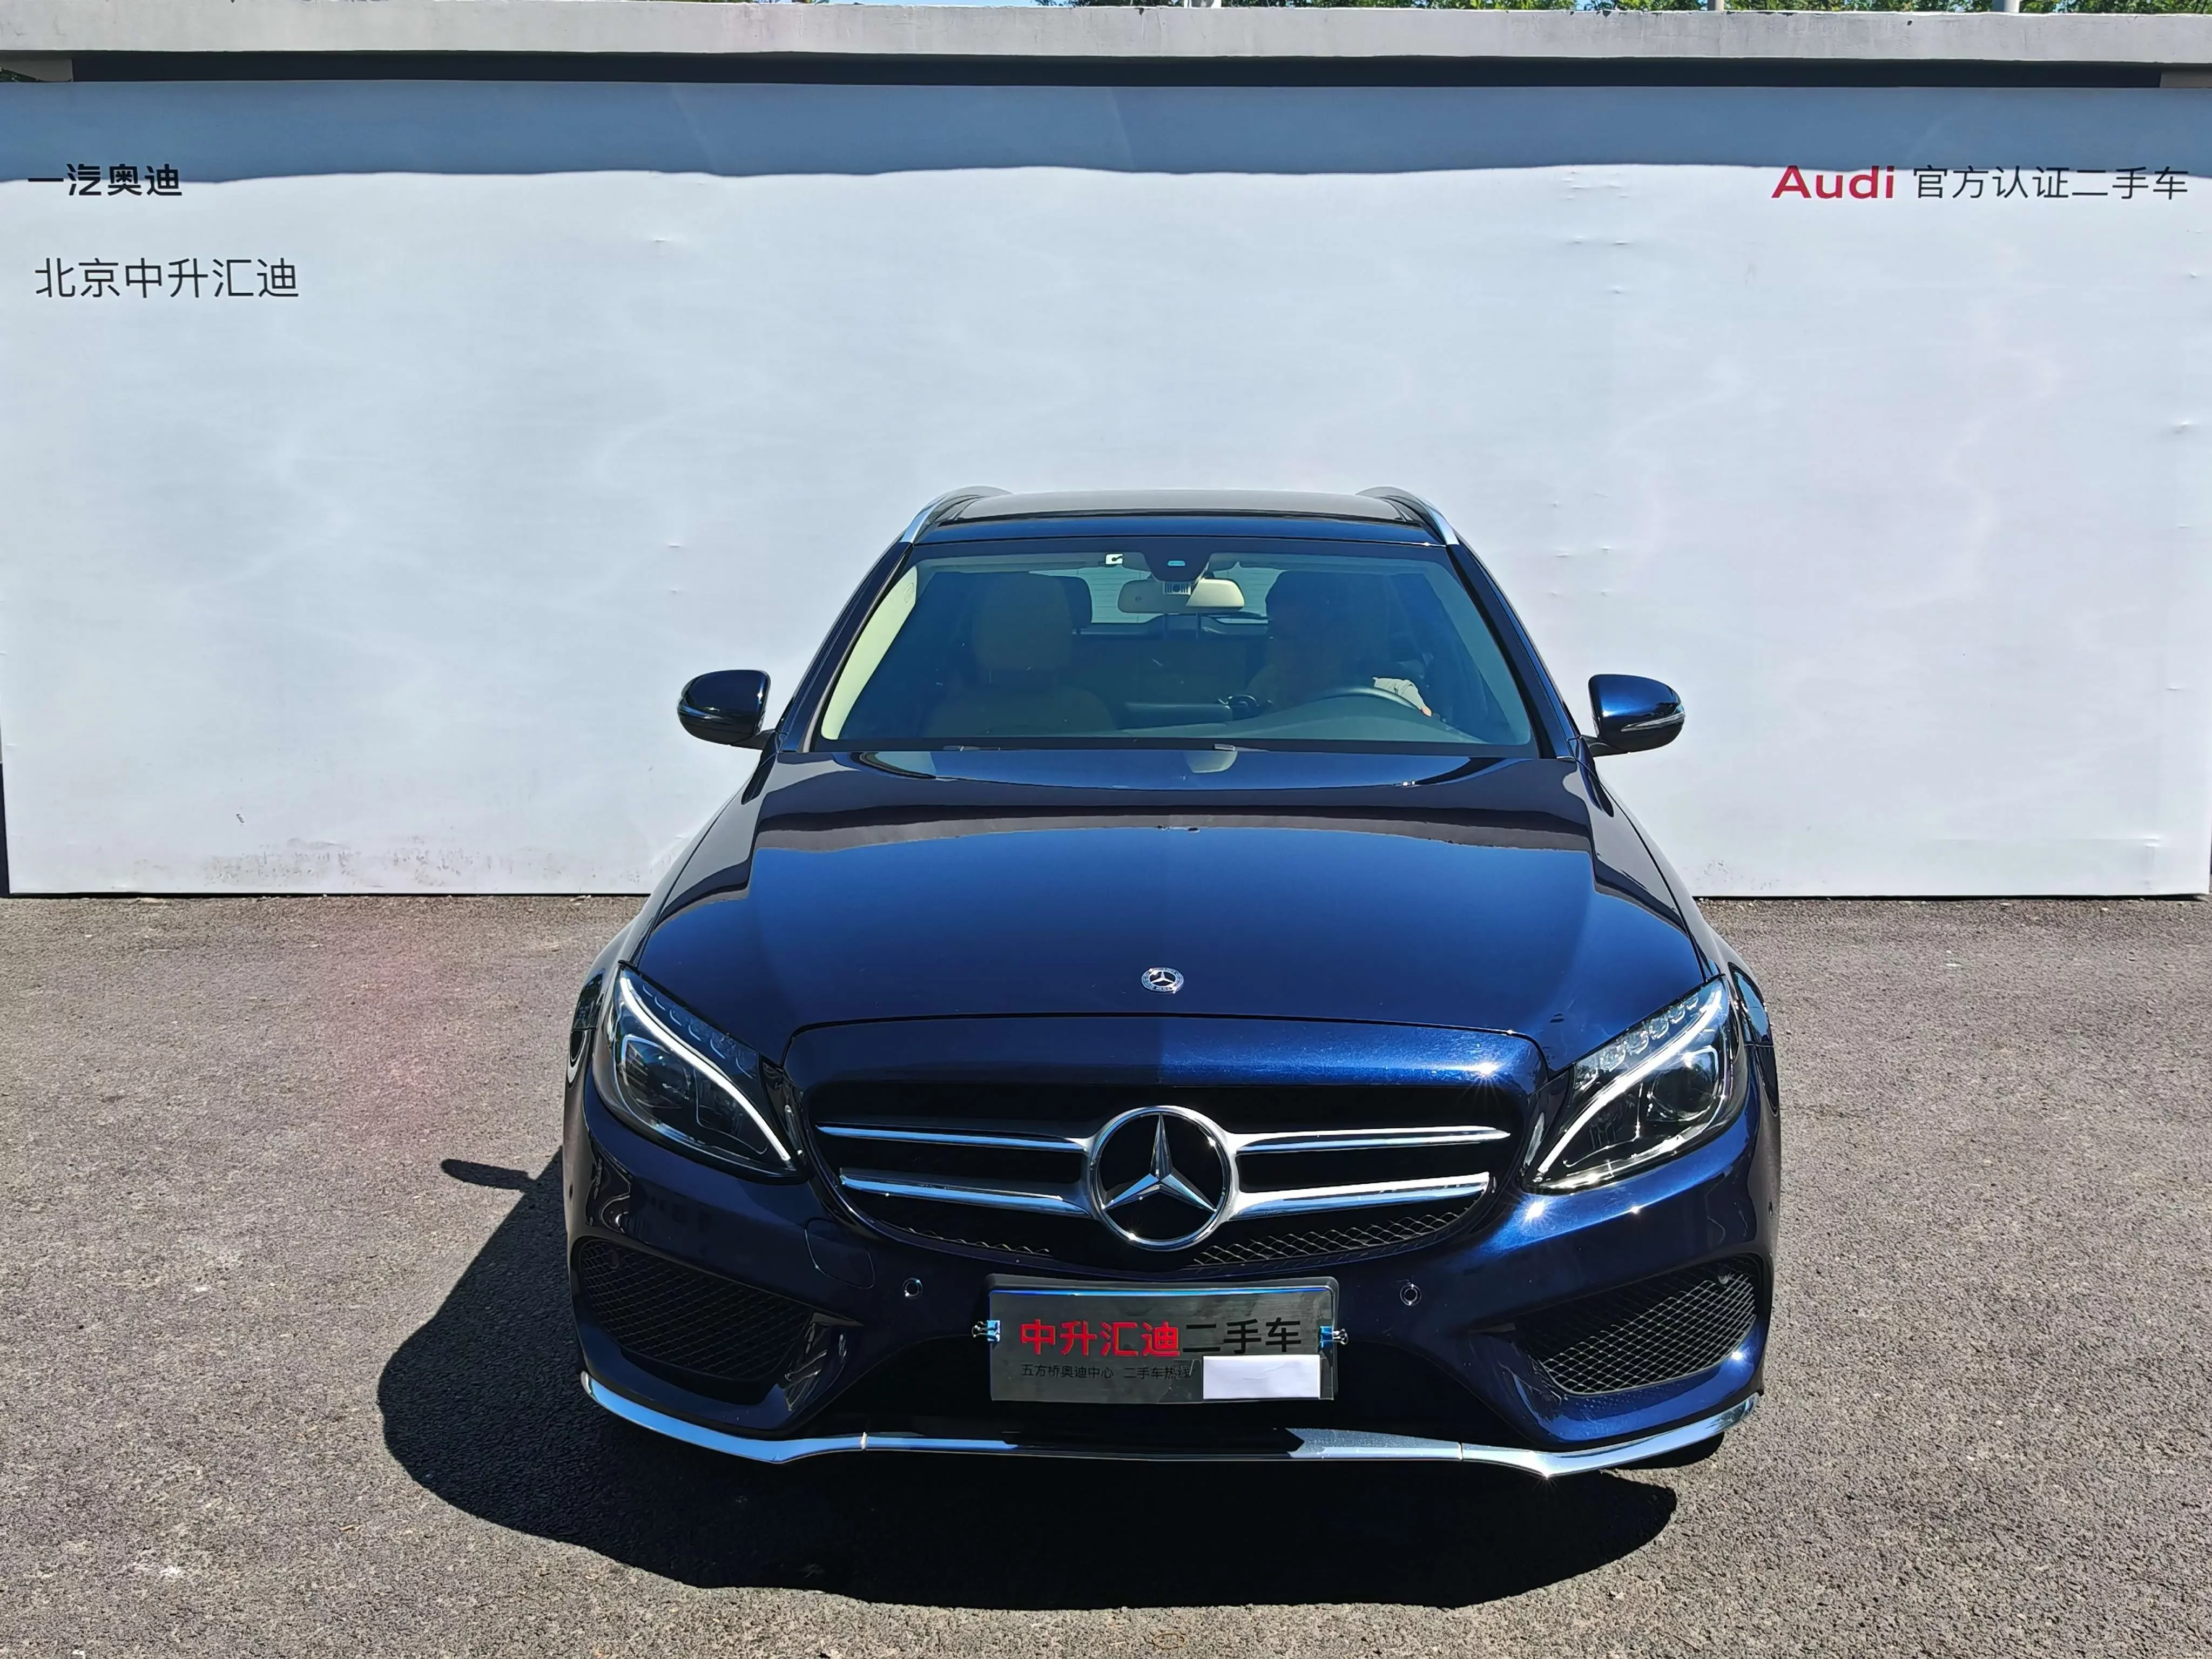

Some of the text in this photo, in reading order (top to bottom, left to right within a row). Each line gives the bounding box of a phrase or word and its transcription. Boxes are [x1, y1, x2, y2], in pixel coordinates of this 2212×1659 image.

[28, 164, 182, 195] 一汽奥迪
[1771, 164, 2189, 200] Audi 官方认证二手车
[35, 258, 299, 298] 北京中升汇迪
[1020, 1318, 1301, 1357] 中升汇迪二手车
[1021, 1364, 1114, 1379] 五方桥奥迪中心
